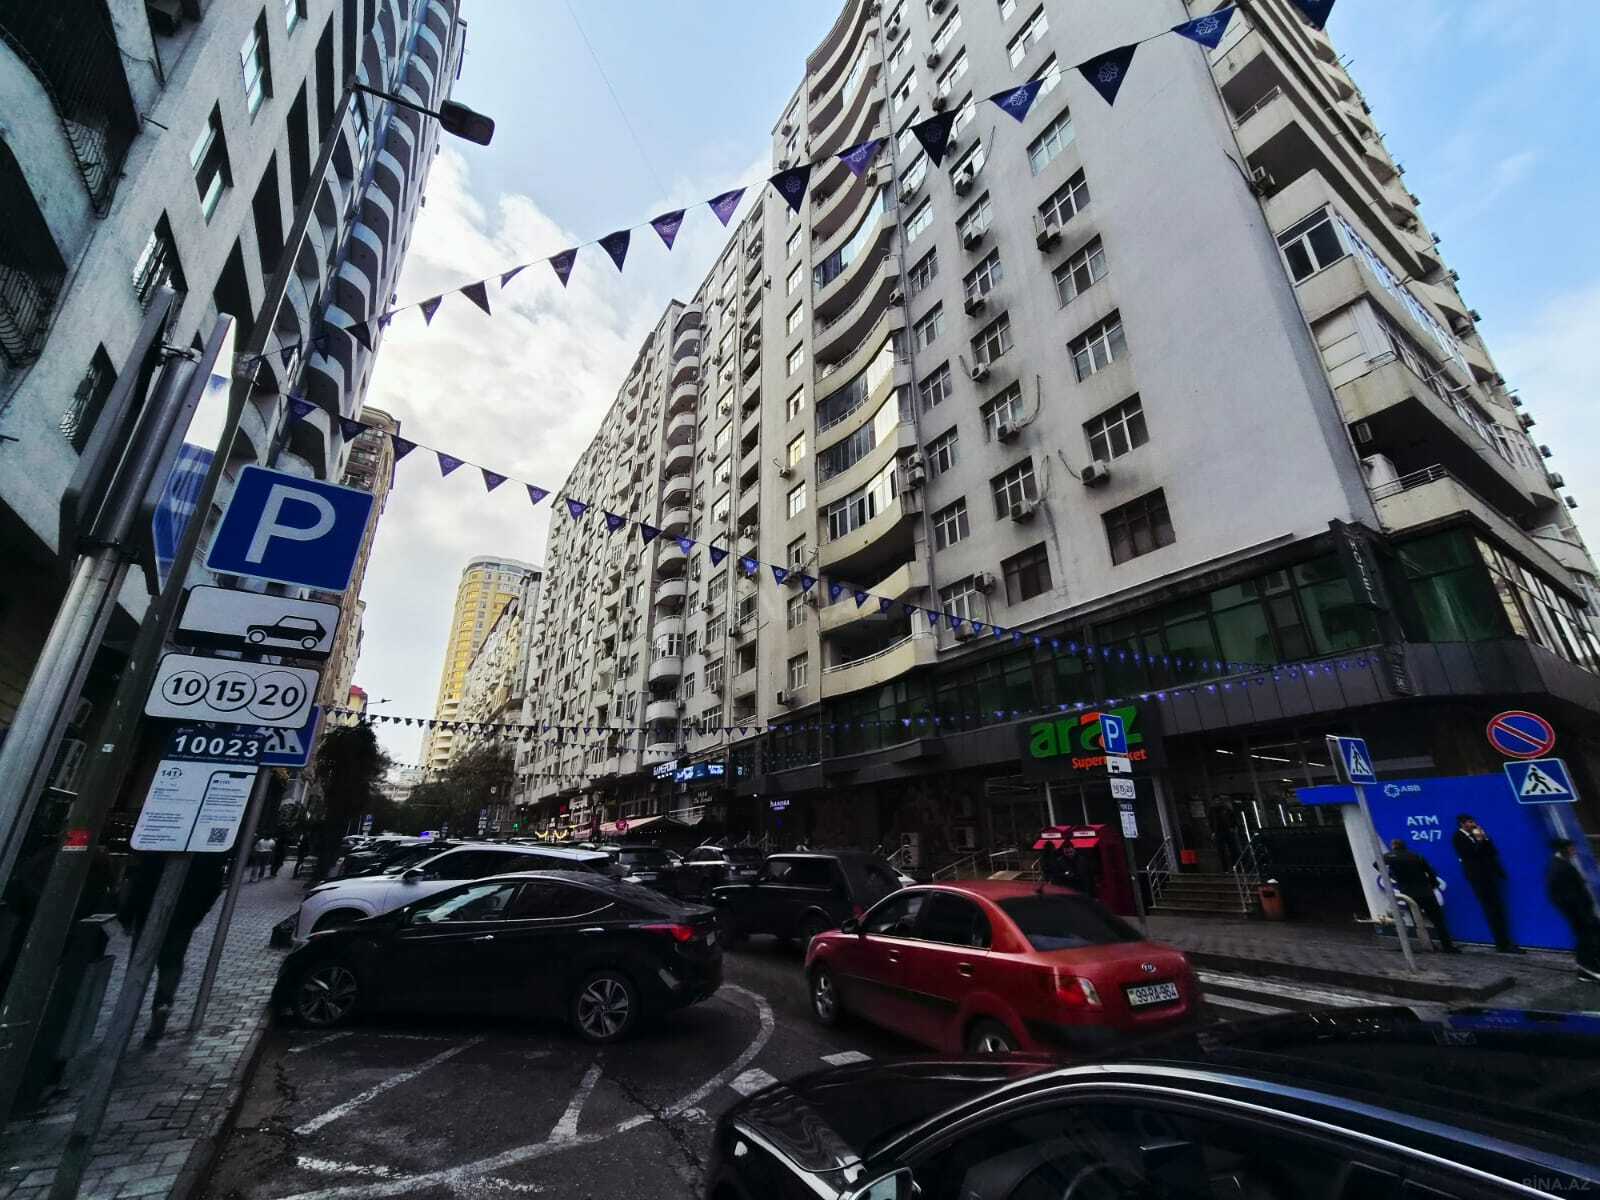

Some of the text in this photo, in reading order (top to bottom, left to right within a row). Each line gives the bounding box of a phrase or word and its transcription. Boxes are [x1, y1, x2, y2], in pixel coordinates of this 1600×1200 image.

[245, 482, 337, 565] P
[171, 676, 300, 708] 10 15 20
[175, 735, 259, 758] 10023
[1106, 719, 1119, 748] P
[1407, 815, 1439, 827] ATM
[1410, 829, 1442, 842] 24/7
